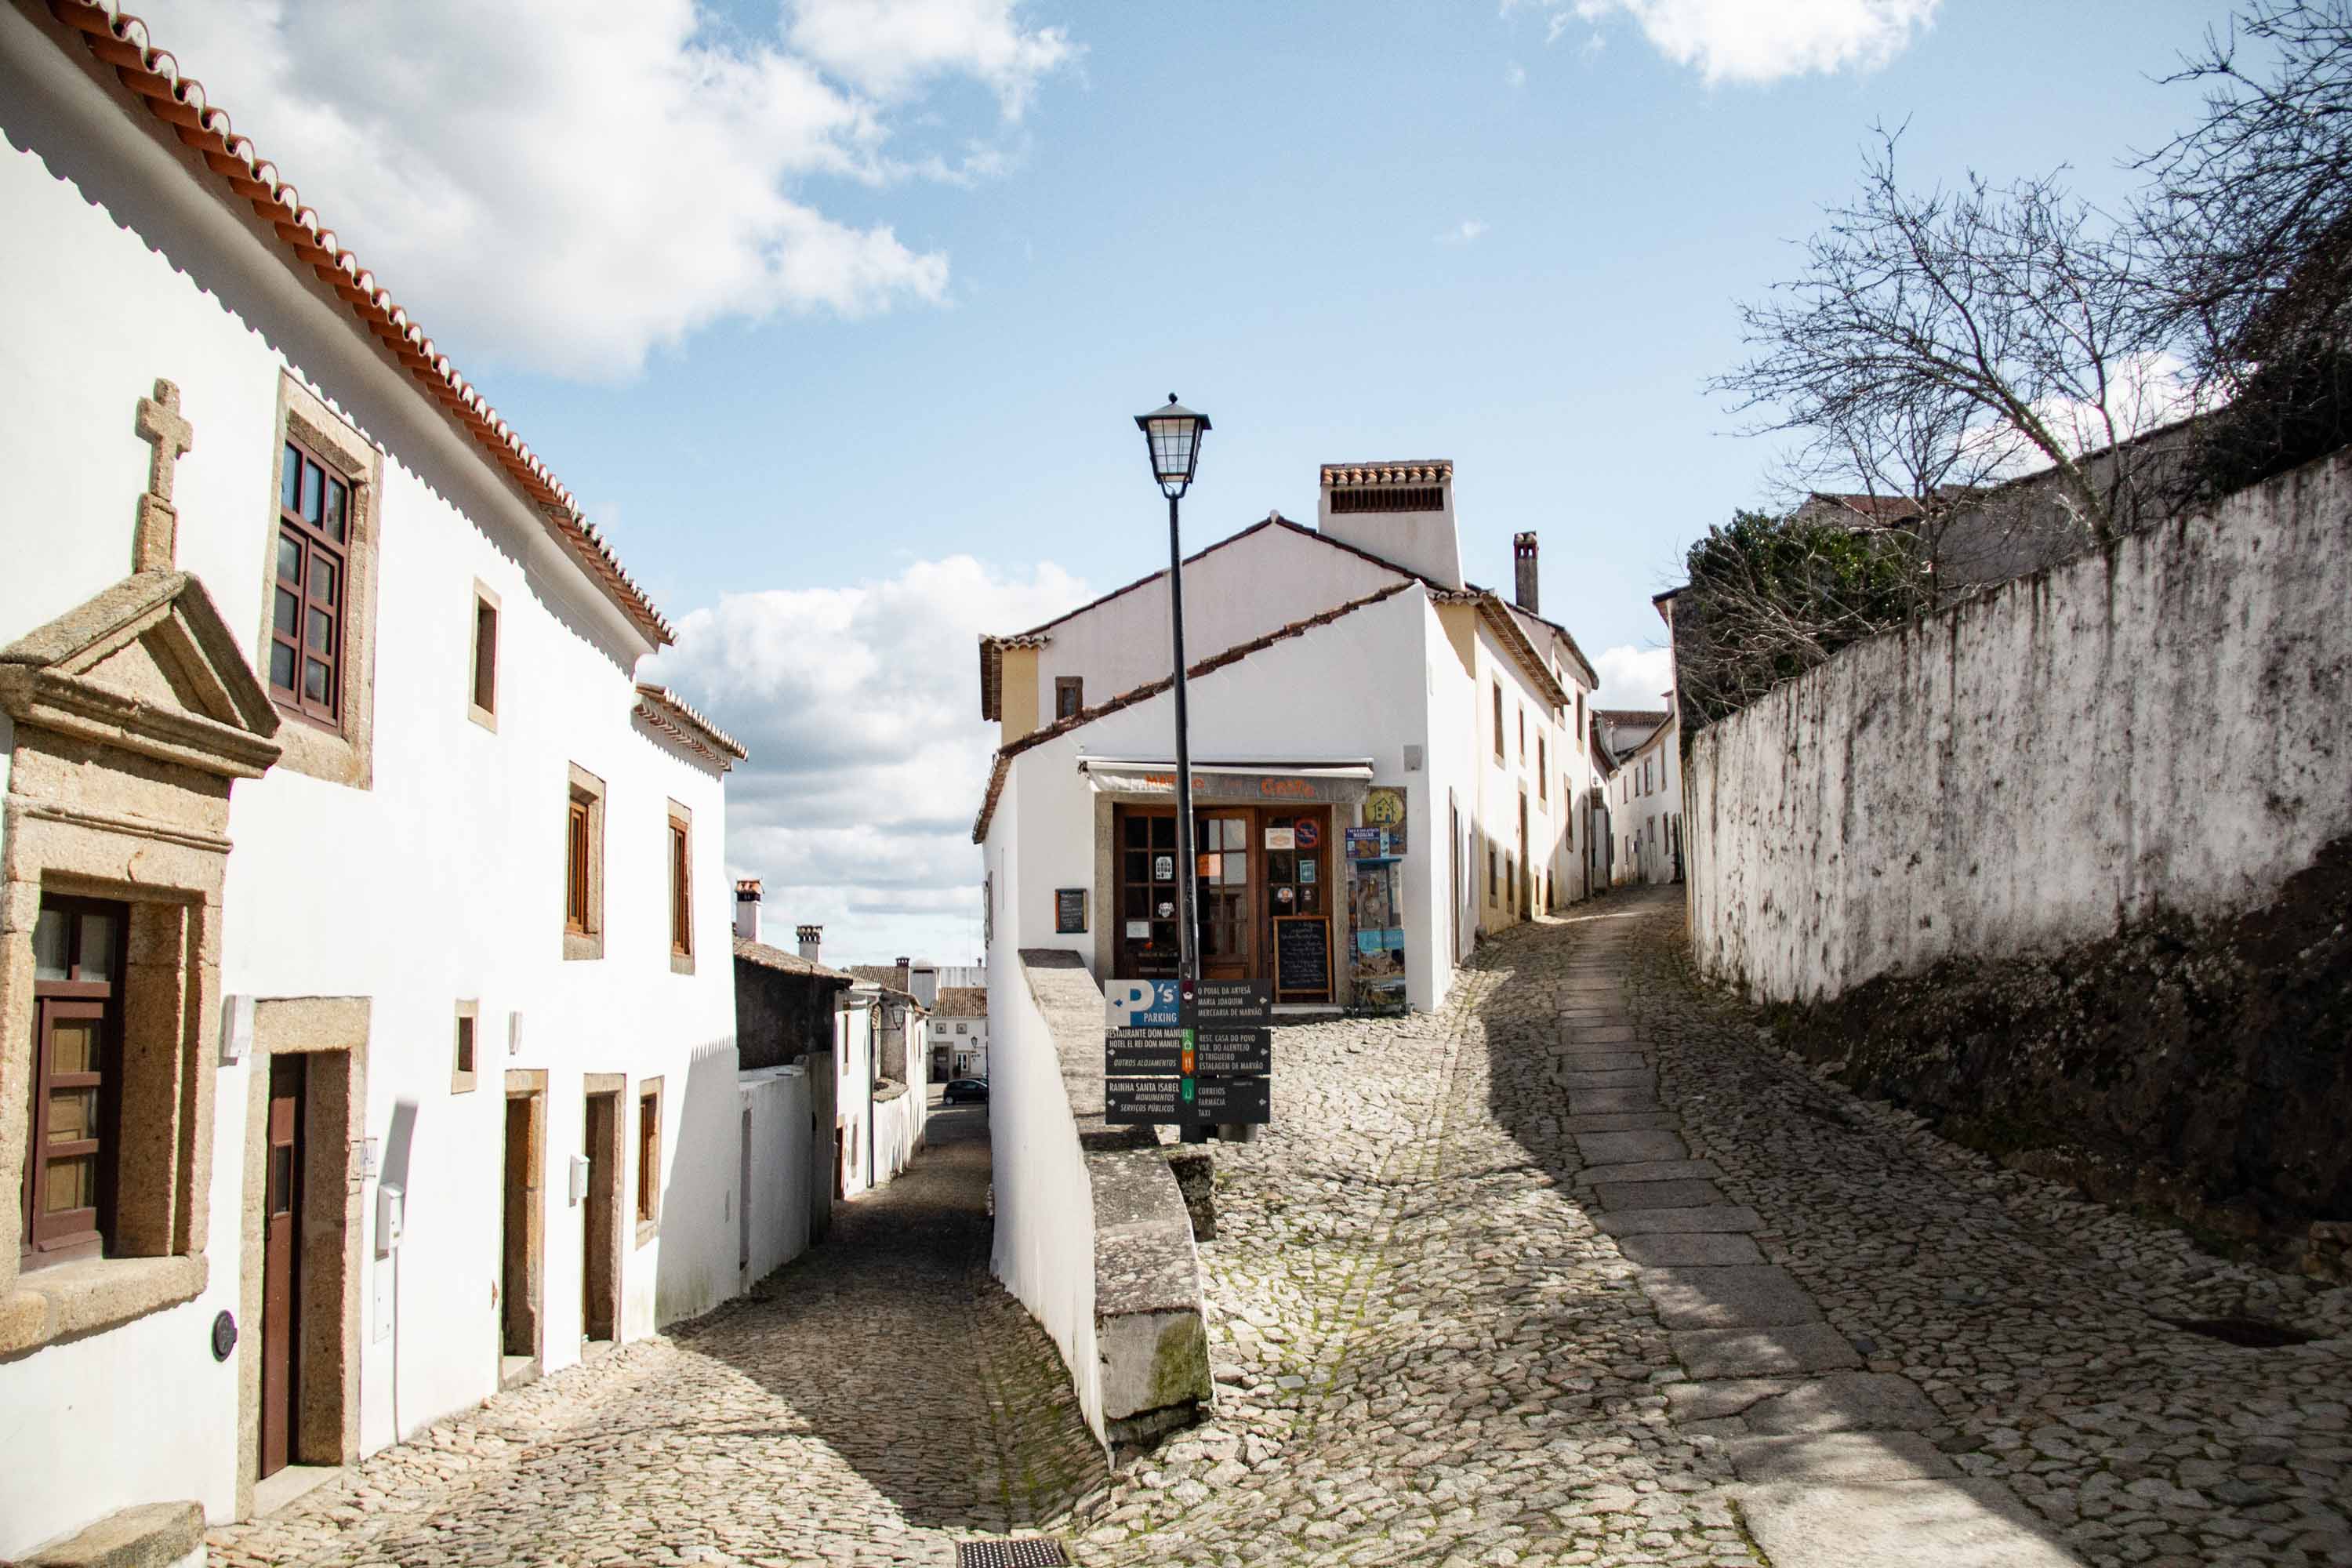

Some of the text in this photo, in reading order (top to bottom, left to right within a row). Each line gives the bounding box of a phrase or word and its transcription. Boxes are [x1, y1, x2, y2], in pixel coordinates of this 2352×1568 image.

[1218, 997, 1243, 1006] JOAQUIM
[1230, 1008, 1238, 1017] DE
[1240, 1007, 1262, 1016] MARVÃO
[1143, 1012, 1178, 1023] PARKING
[1105, 1028, 1189, 1038] RESTAURANTE DOM MANUEL
[1158, 1040, 1181, 1048] MANUEL
[1242, 1061, 1264, 1070] MARVÃO
[1109, 1083, 1180, 1092] RAINHA SANTA ISABEL
[1147, 1104, 1175, 1112] PÚBLICOS
